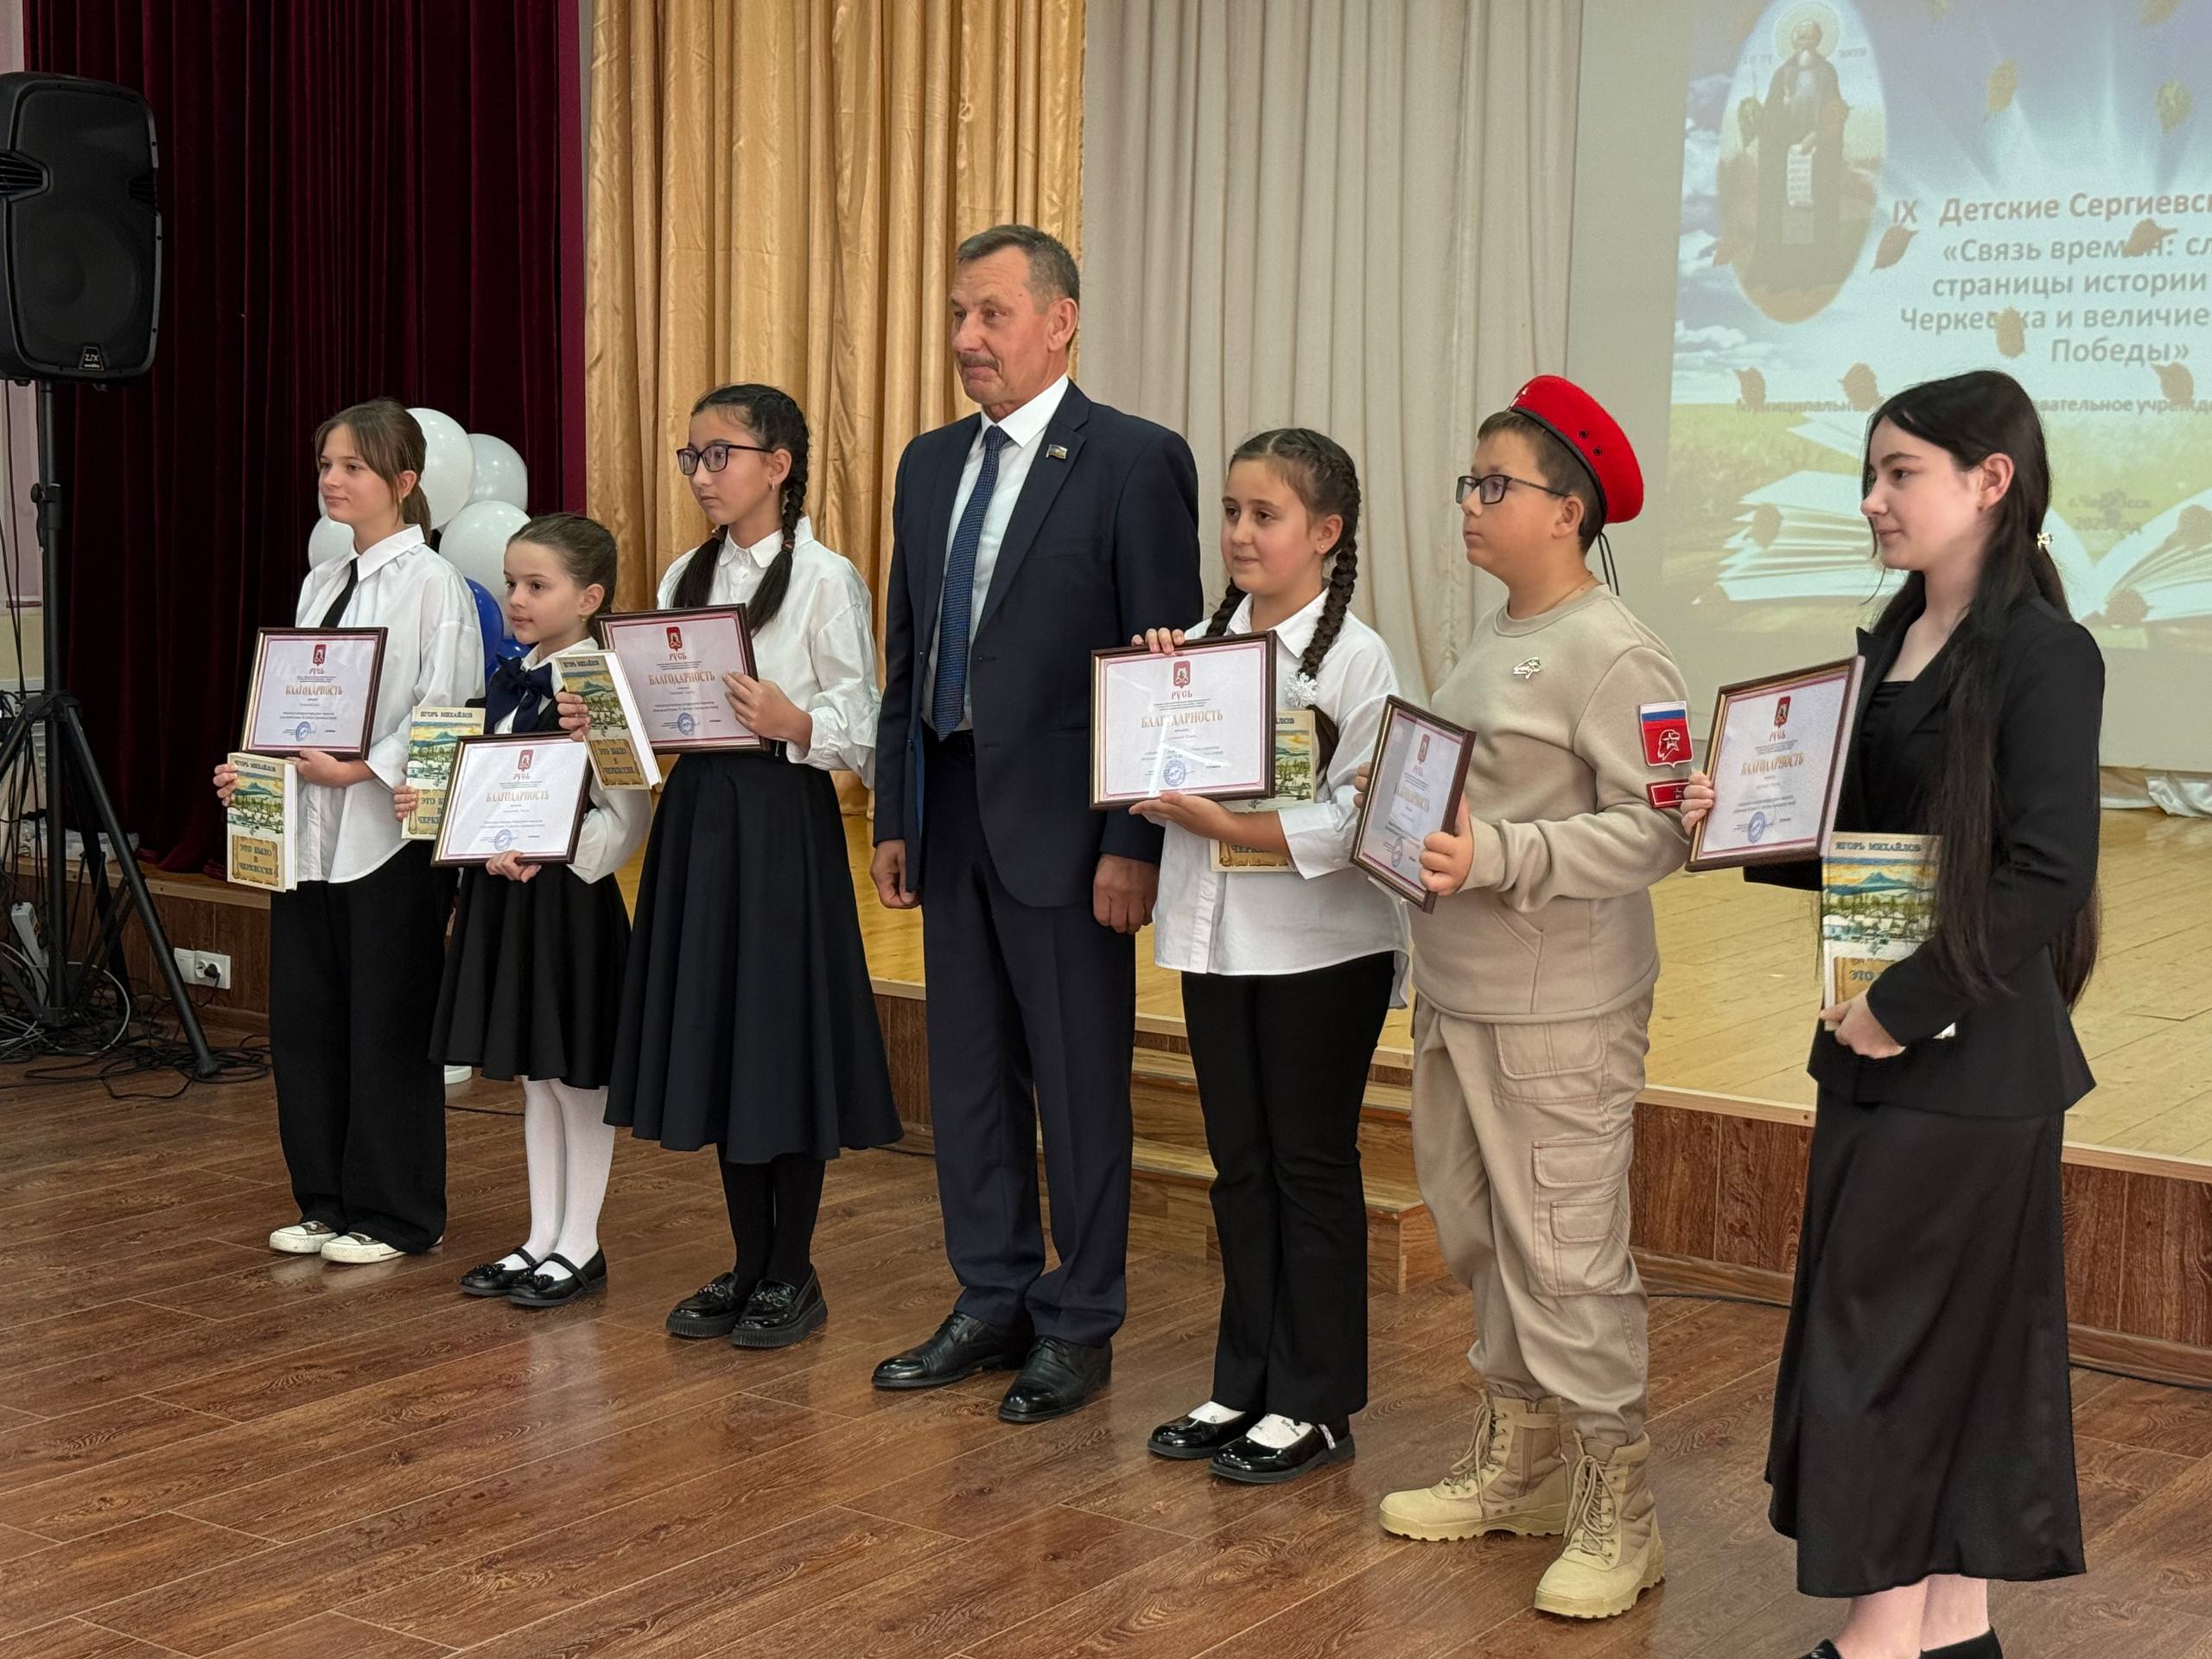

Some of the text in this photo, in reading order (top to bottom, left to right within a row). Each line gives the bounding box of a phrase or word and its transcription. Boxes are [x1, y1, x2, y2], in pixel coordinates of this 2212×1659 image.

[1893, 200, 1918, 224] IX
[1938, 197, 2060, 228] Детские
[1942, 238, 2042, 262] «Связь
[1932, 272, 2208, 302] страницы истории
[1900, 307, 2211, 336] Черкеска и величие
[2050, 336, 2190, 367] Победы»
